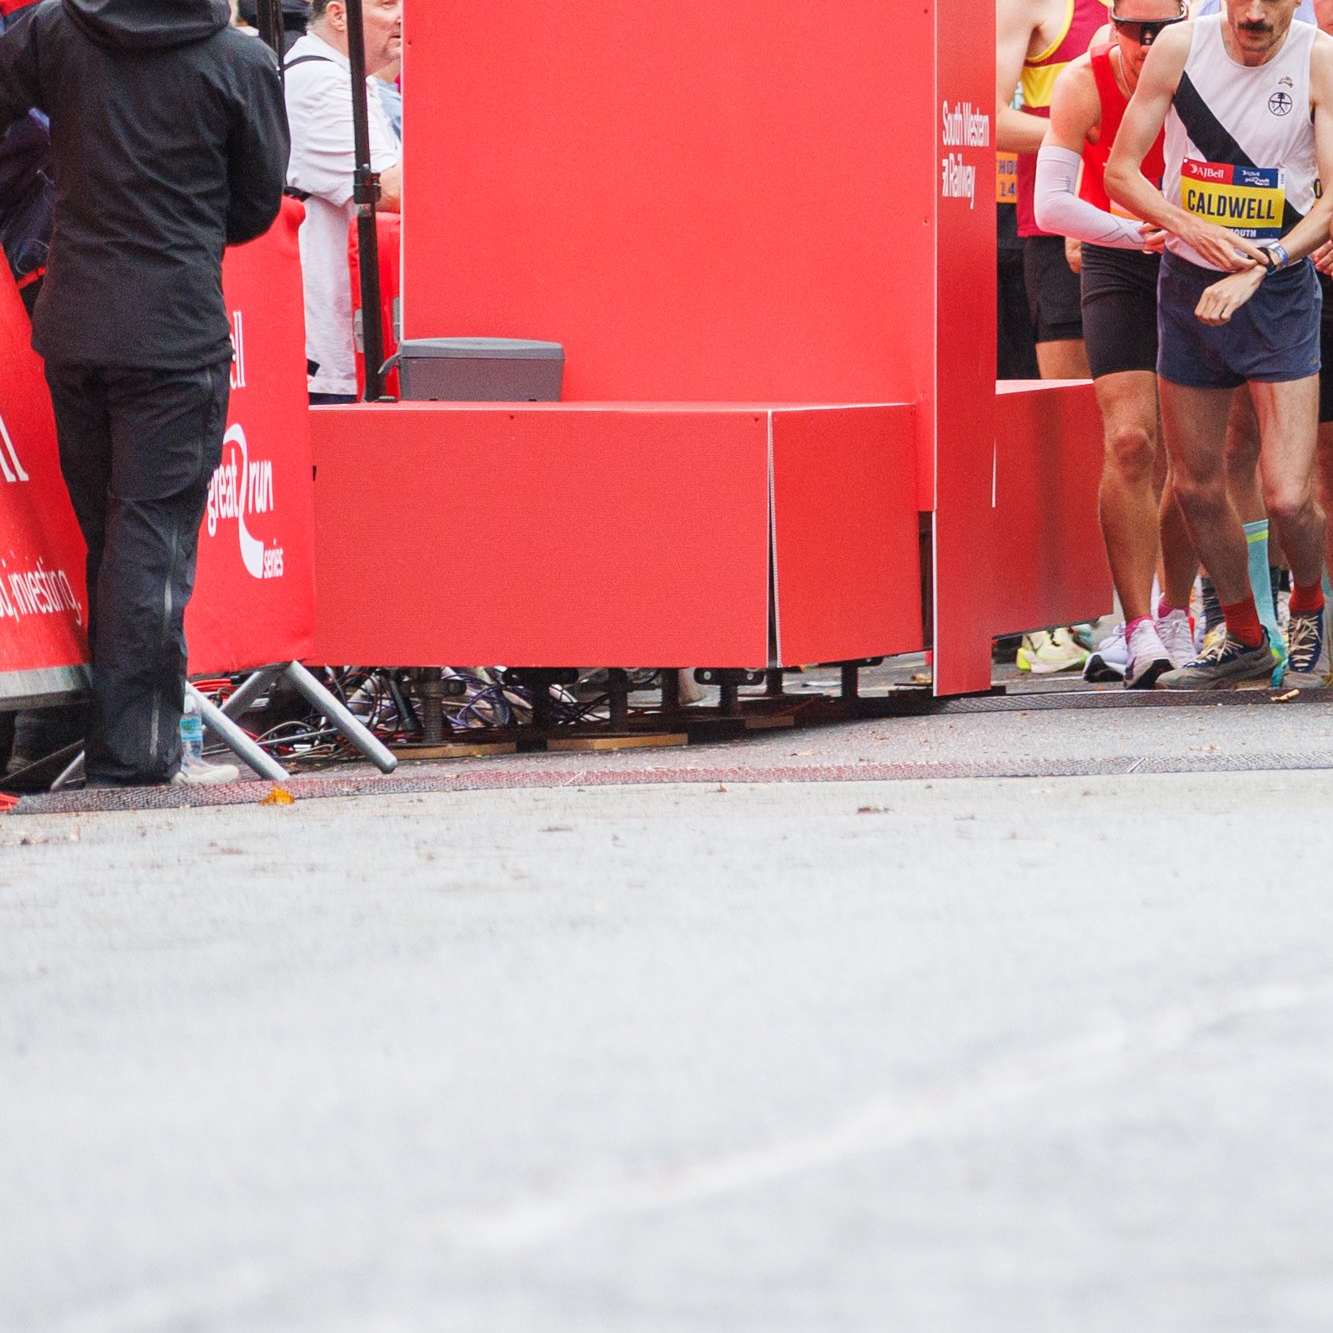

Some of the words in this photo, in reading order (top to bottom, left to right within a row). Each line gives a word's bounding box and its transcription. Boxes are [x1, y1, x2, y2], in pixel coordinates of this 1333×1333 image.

[942, 100, 963, 147] South
[963, 101, 990, 148] Western
[948, 152, 976, 210] Railway
[1187, 188, 1276, 220] CALDWELL
[206, 447, 240, 538] great
[248, 460, 274, 515] run
[263, 538, 284, 580] series
